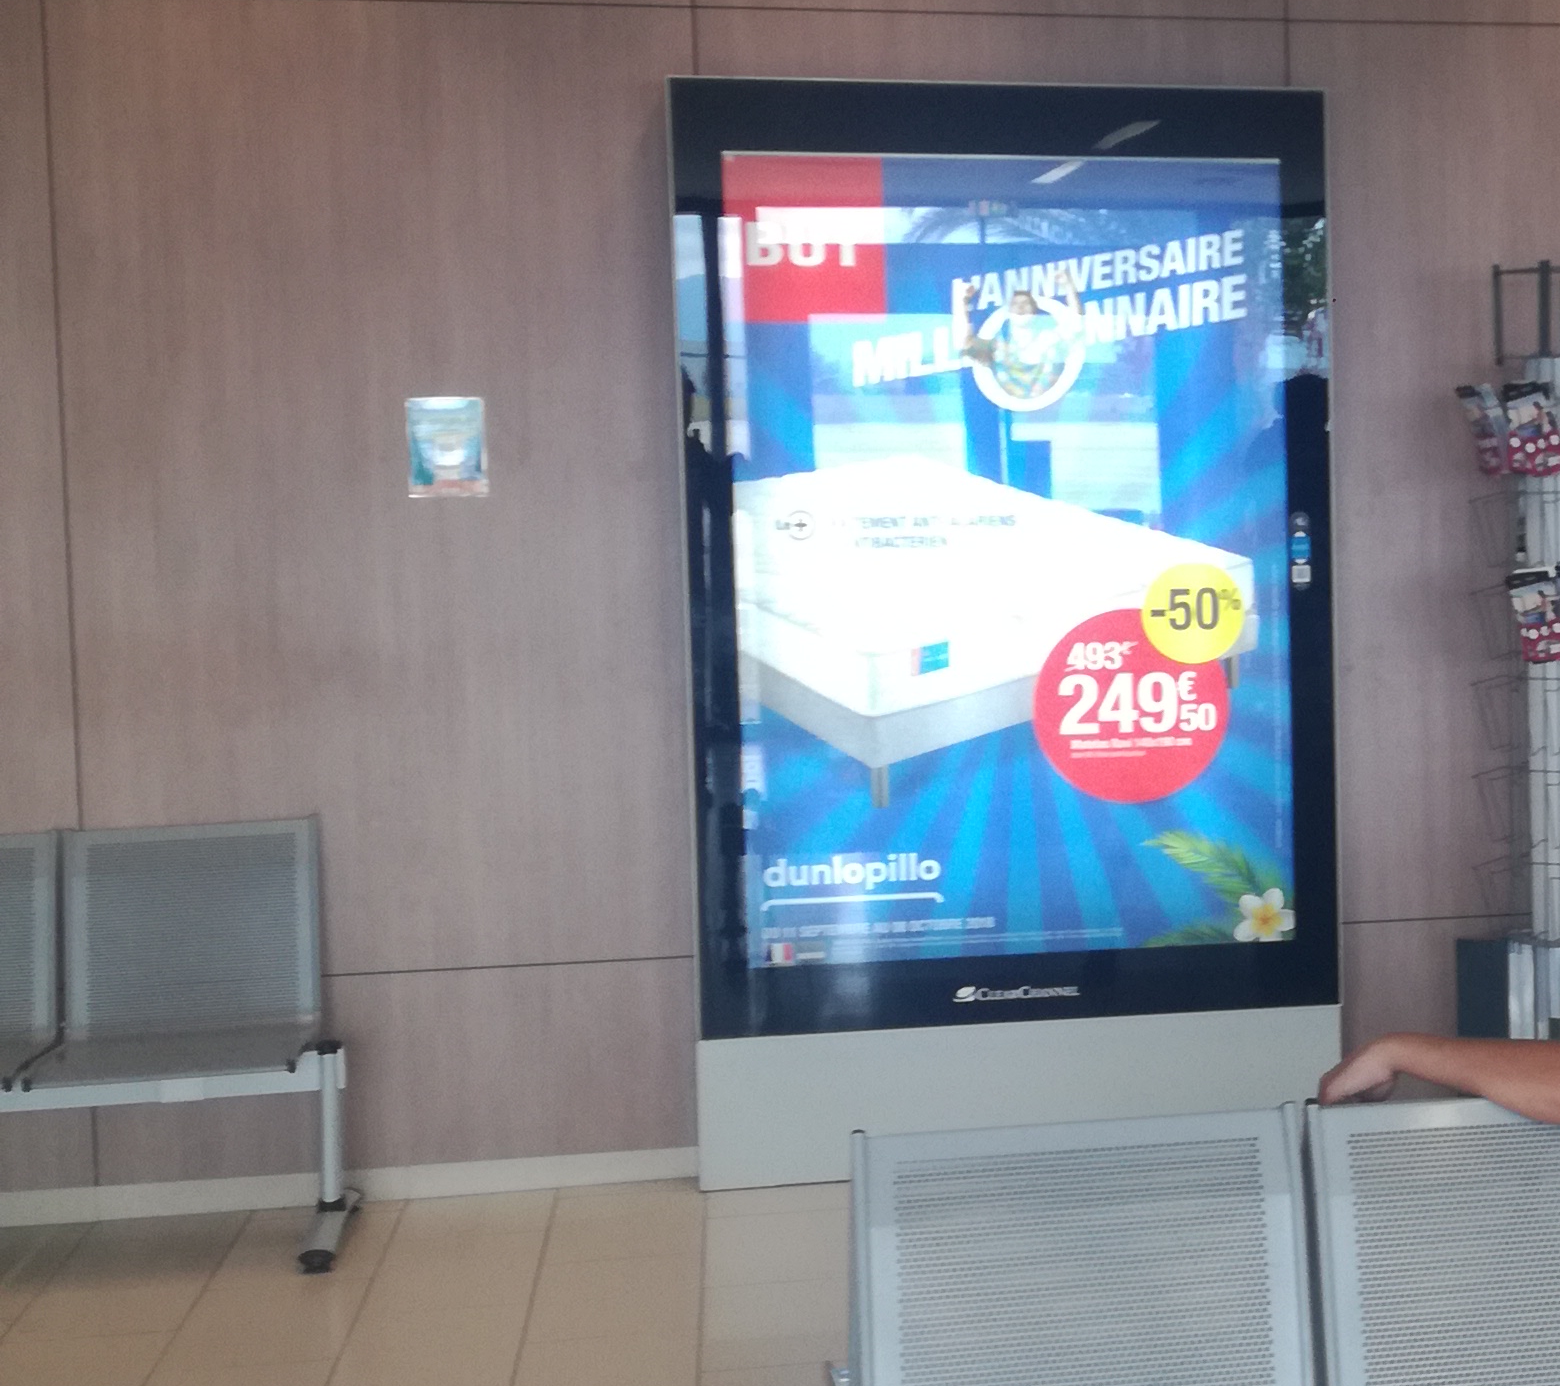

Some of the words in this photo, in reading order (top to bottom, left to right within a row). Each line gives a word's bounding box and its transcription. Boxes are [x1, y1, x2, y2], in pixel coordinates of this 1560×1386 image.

[746, 221, 857, 268] BUT
[1150, 587, 1243, 631] -50%
[763, 852, 942, 891] dunlopillo
